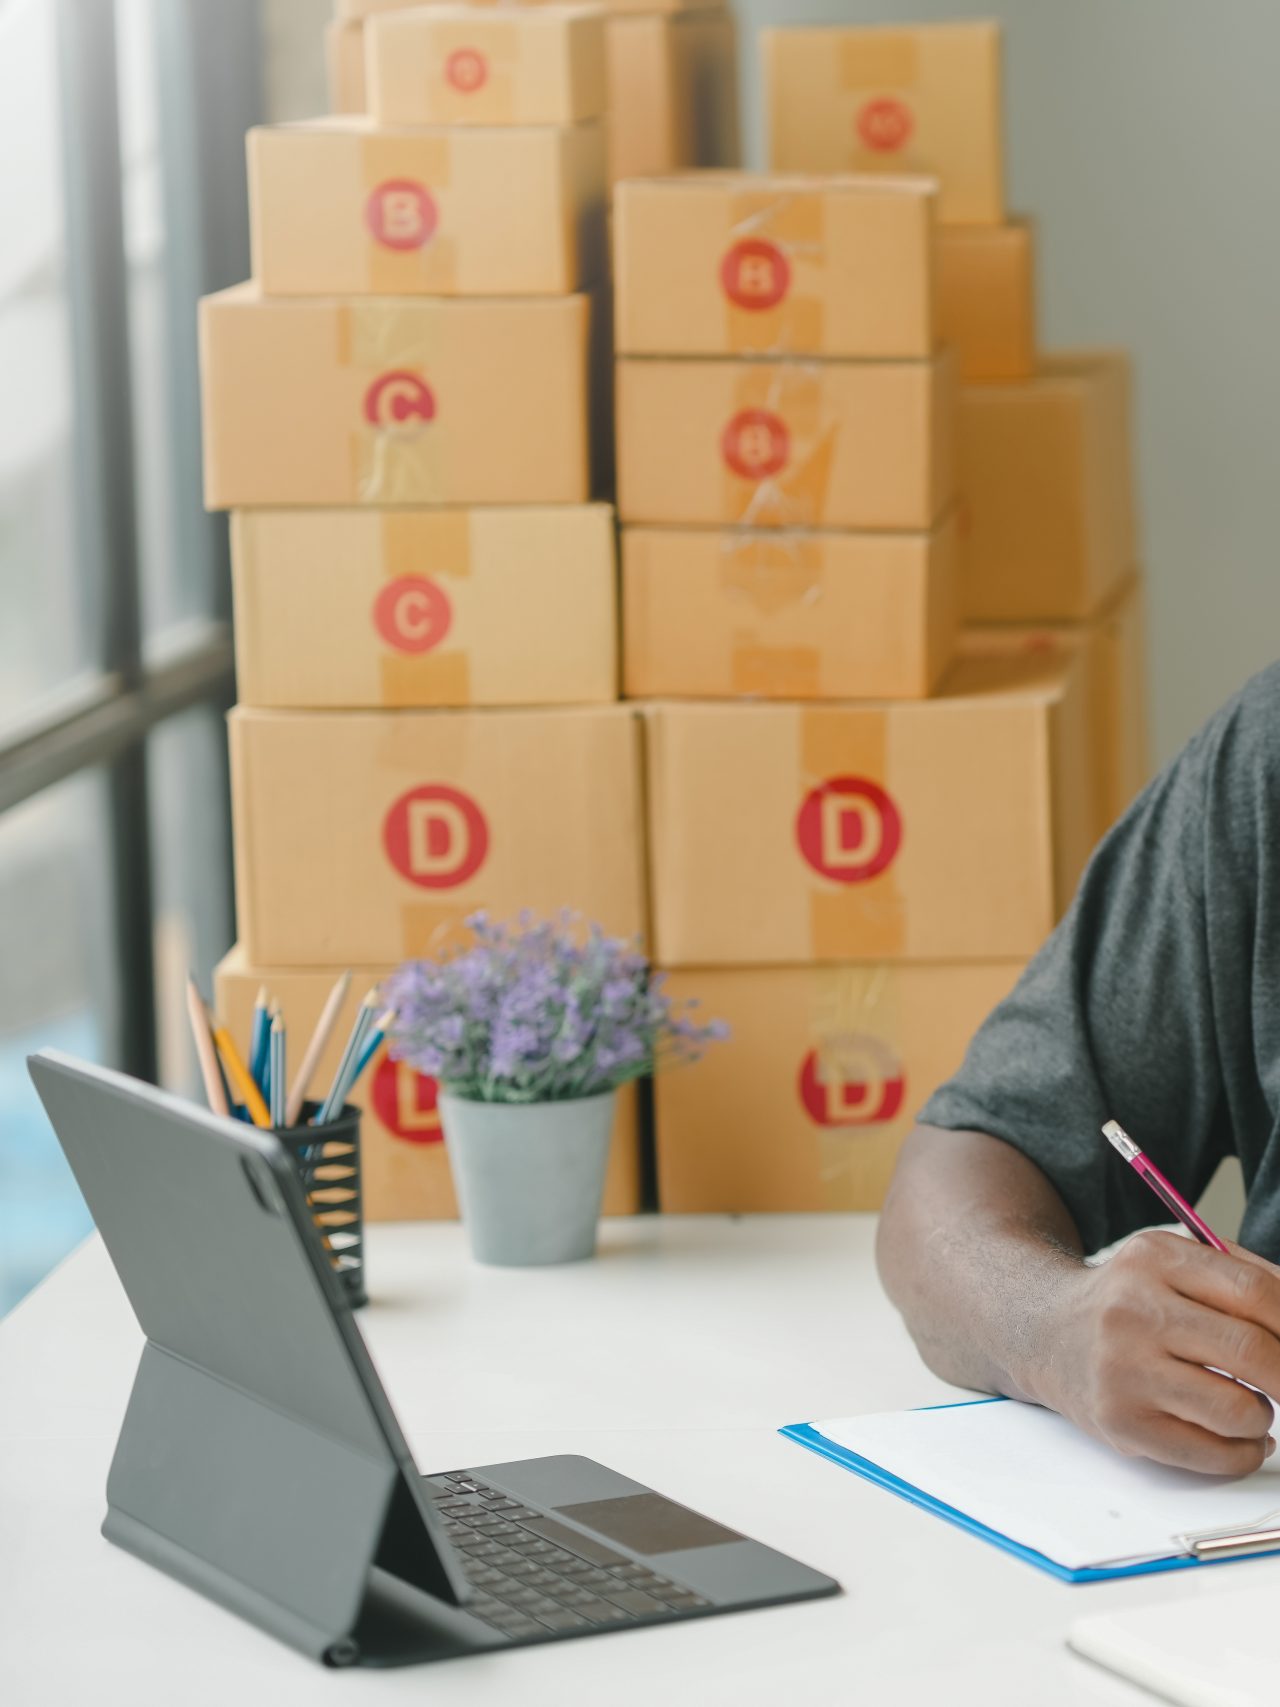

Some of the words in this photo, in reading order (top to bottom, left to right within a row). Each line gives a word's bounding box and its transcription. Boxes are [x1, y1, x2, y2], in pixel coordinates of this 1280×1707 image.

[382, 191, 420, 236] B
[738, 255, 775, 295] B
[376, 380, 421, 430] C
[395, 590, 432, 640] C
[407, 800, 471, 877] D
[820, 792, 884, 870] D
[821, 1049, 885, 1123] D
